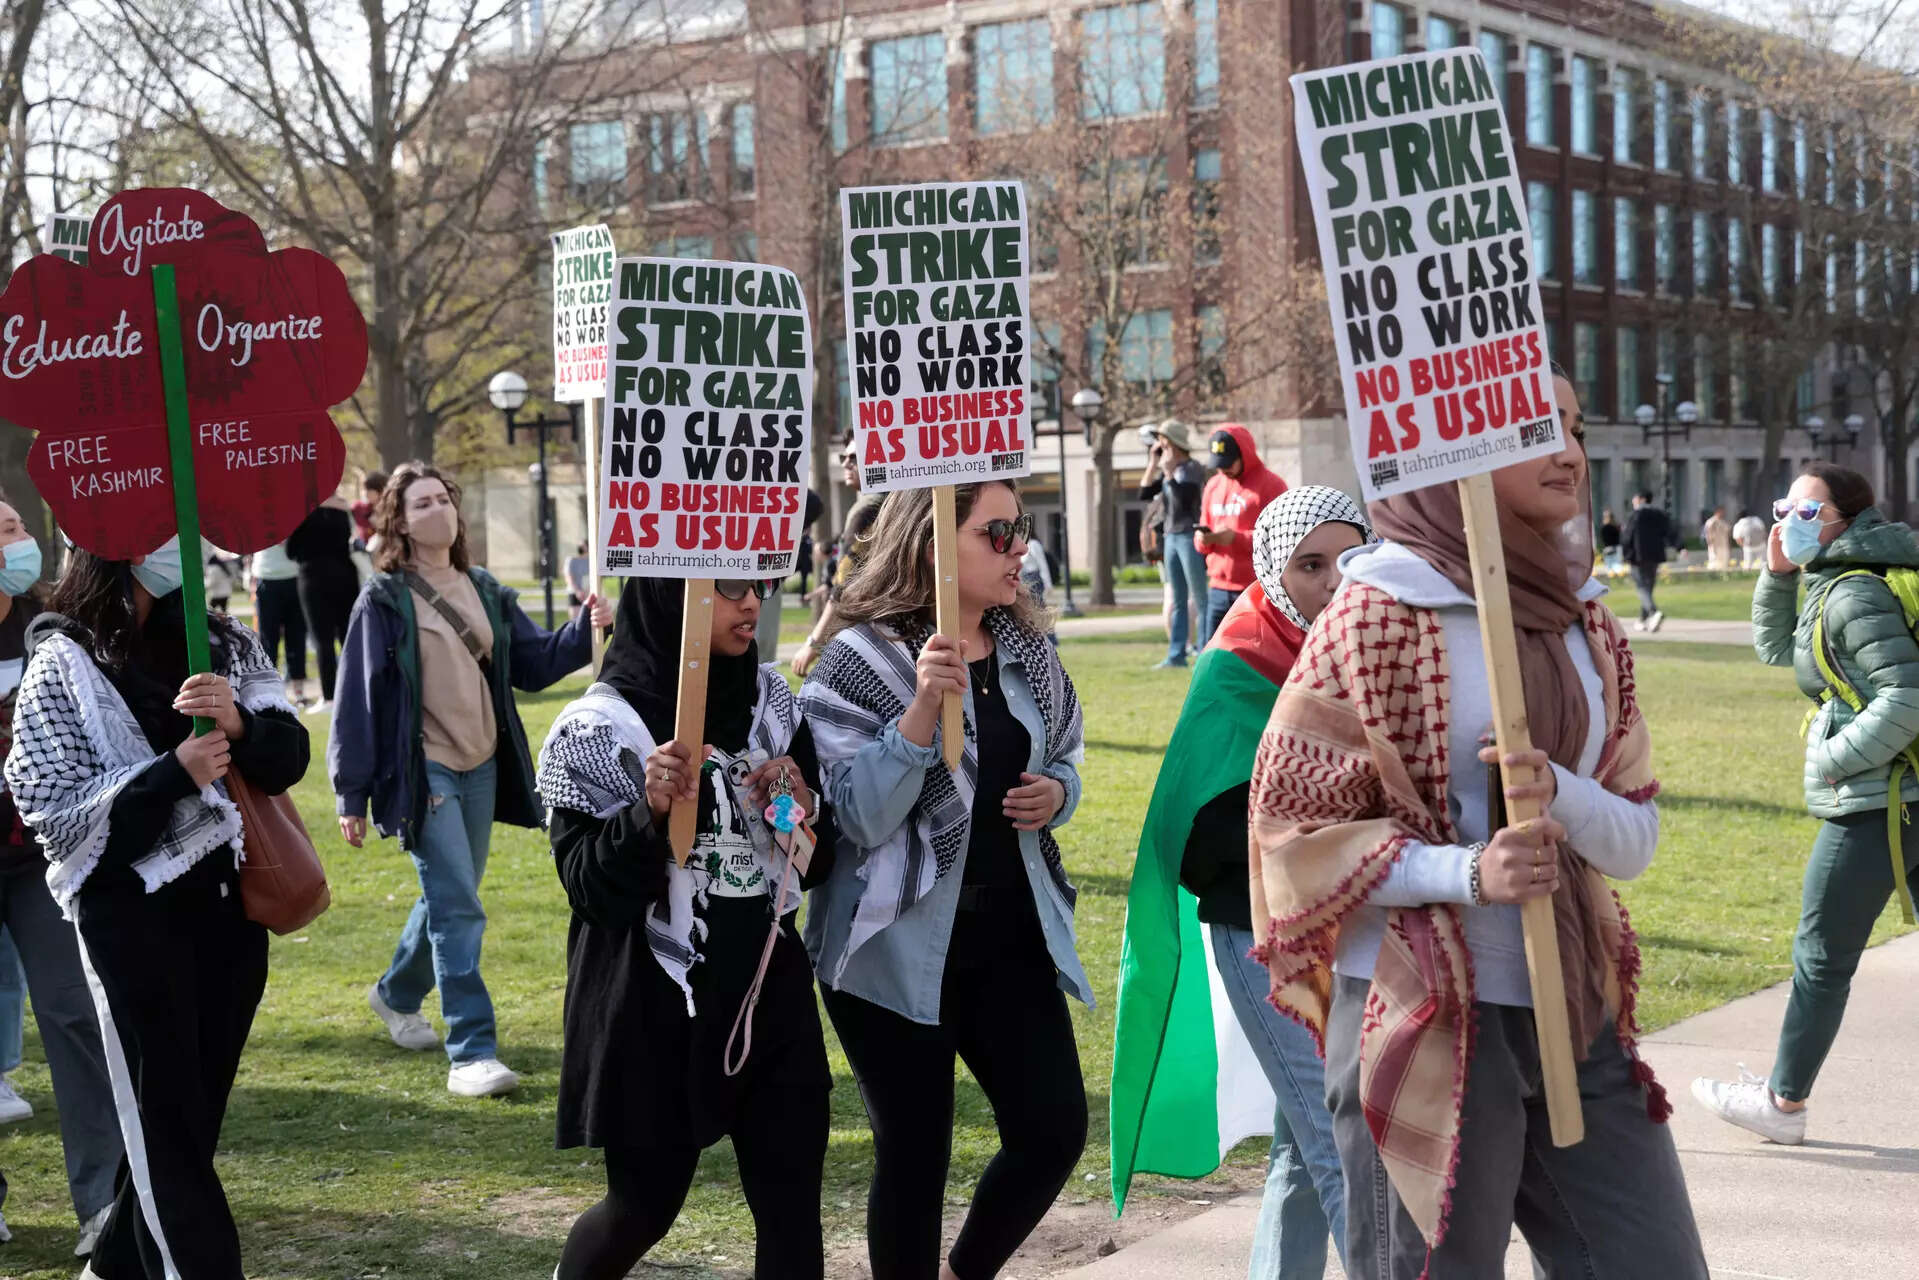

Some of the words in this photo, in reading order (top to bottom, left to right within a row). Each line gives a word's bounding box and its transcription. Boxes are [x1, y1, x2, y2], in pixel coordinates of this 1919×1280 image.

[1305, 54, 1494, 128] MICHIGAN
[1320, 109, 1511, 210] STRIKE
[849, 186, 1019, 229] MICHIGAN
[1332, 206, 1418, 267] FOR
[1427, 185, 1522, 246] GAZA
[100, 204, 204, 275] Agitate
[556, 228, 611, 253] MICHIGAN
[851, 227, 1021, 287] STRIKE
[557, 251, 612, 286] STRIKE
[620, 263, 801, 310] MICHIGAN
[1341, 265, 1397, 319] NO
[1417, 237, 1528, 301] CLASS
[557, 288, 575, 308] FOR
[580, 283, 611, 304] GAZA
[558, 310, 570, 328] NO
[576, 306, 610, 326] CLAS
[853, 289, 921, 328] FOR
[930, 282, 1022, 322] GAZA
[3, 310, 142, 378] Educate
[198, 304, 322, 366] Organize
[557, 328, 570, 346] NO
[576, 326, 608, 344] WOR
[616, 307, 805, 368] STRIKE
[855, 329, 901, 365] NO
[918, 321, 1023, 359] CLASS
[1347, 314, 1403, 365] NO
[1421, 284, 1536, 347] WORK
[558, 350, 568, 363] NO
[560, 366, 572, 383] AS
[577, 362, 606, 382] USUA
[857, 364, 900, 398] NO
[917, 355, 1023, 392] WORK
[1356, 365, 1400, 408] NO
[1409, 331, 1542, 396] BUSINESS
[614, 366, 691, 407] FOR
[703, 371, 804, 411] GAZA
[859, 400, 893, 429] NO
[903, 389, 1023, 425] BUSINESS
[200, 422, 251, 445] FREE
[613, 408, 665, 444] NO
[685, 411, 803, 448] CLASS
[1368, 403, 1420, 459] AS
[1433, 372, 1551, 444] USUAL
[48, 436, 110, 469] FREE
[611, 444, 661, 478] NO
[683, 447, 801, 482] WORK
[865, 429, 905, 465] AS
[918, 418, 1024, 459] USUAL
[1402, 435, 1516, 475] tahrirumich.org
[71, 468, 163, 498] KASHMIR
[890, 460, 986, 479] tahrirumich.org
[609, 481, 650, 510] NO
[661, 483, 799, 514] BUSINESS
[608, 512, 659, 548] AS
[676, 515, 794, 551] USUAL
[638, 552, 750, 570] tahrirumich.org
